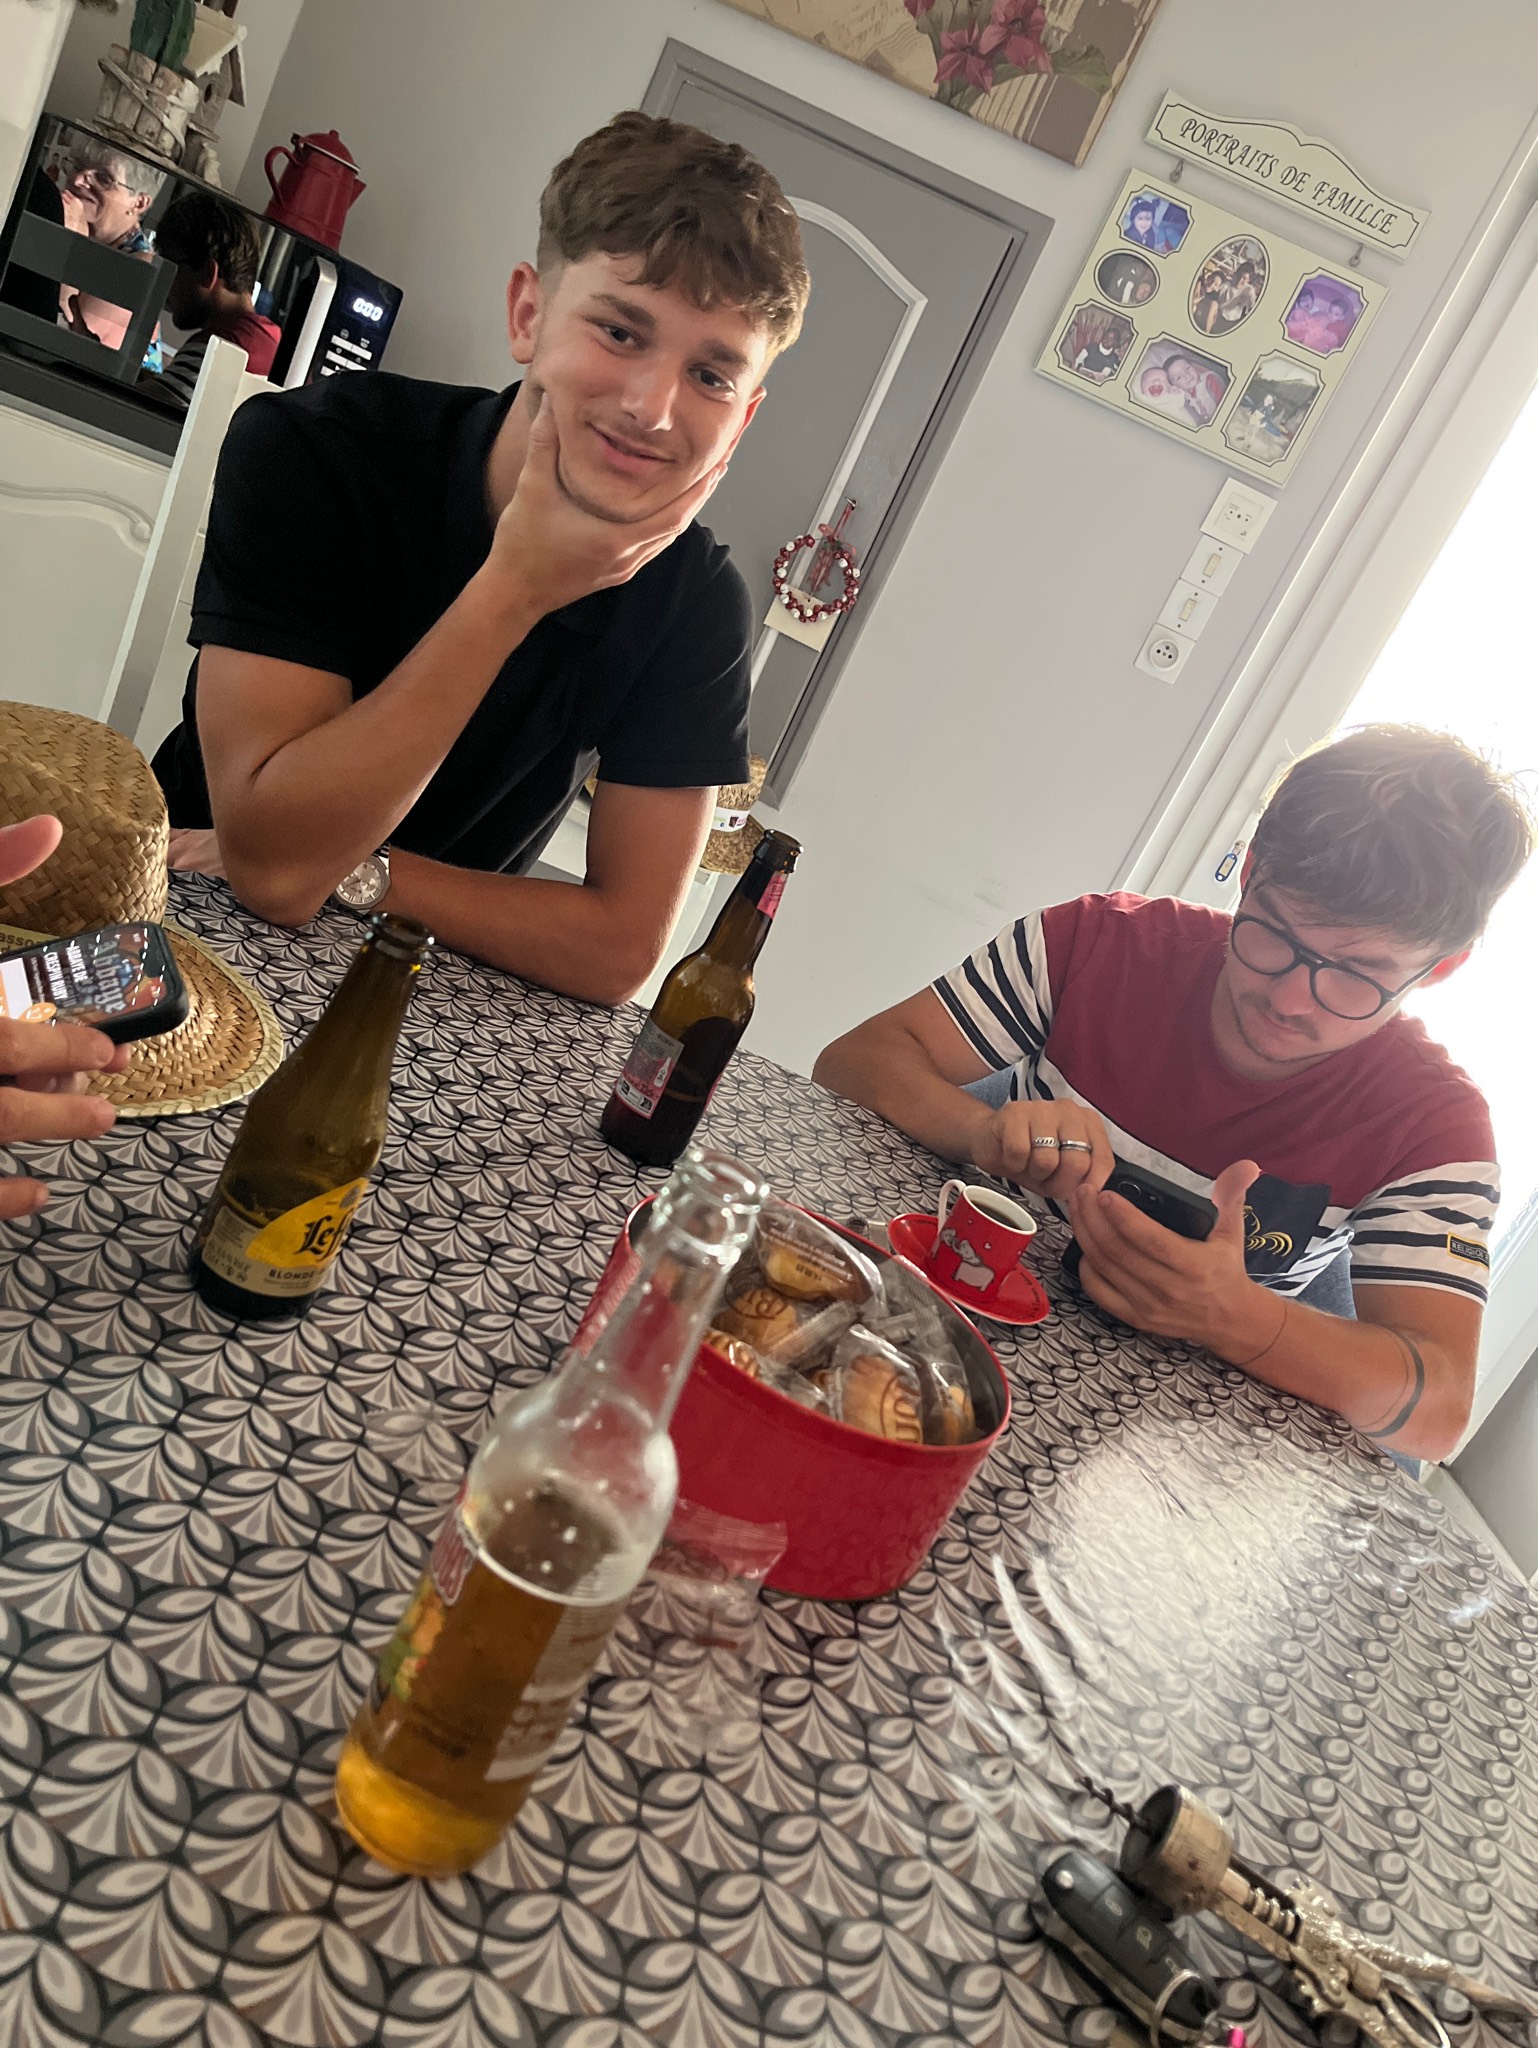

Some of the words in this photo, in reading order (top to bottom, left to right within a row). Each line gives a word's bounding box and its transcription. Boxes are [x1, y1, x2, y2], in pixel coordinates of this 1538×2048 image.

[1180, 118, 1280, 179] PORTRAITS
[1280, 165, 1311, 193] DE
[1312, 180, 1398, 235] FAMILLE
[1451, 1242, 1484, 1258] RELIGION
[269, 1270, 316, 1280] BLONDE
